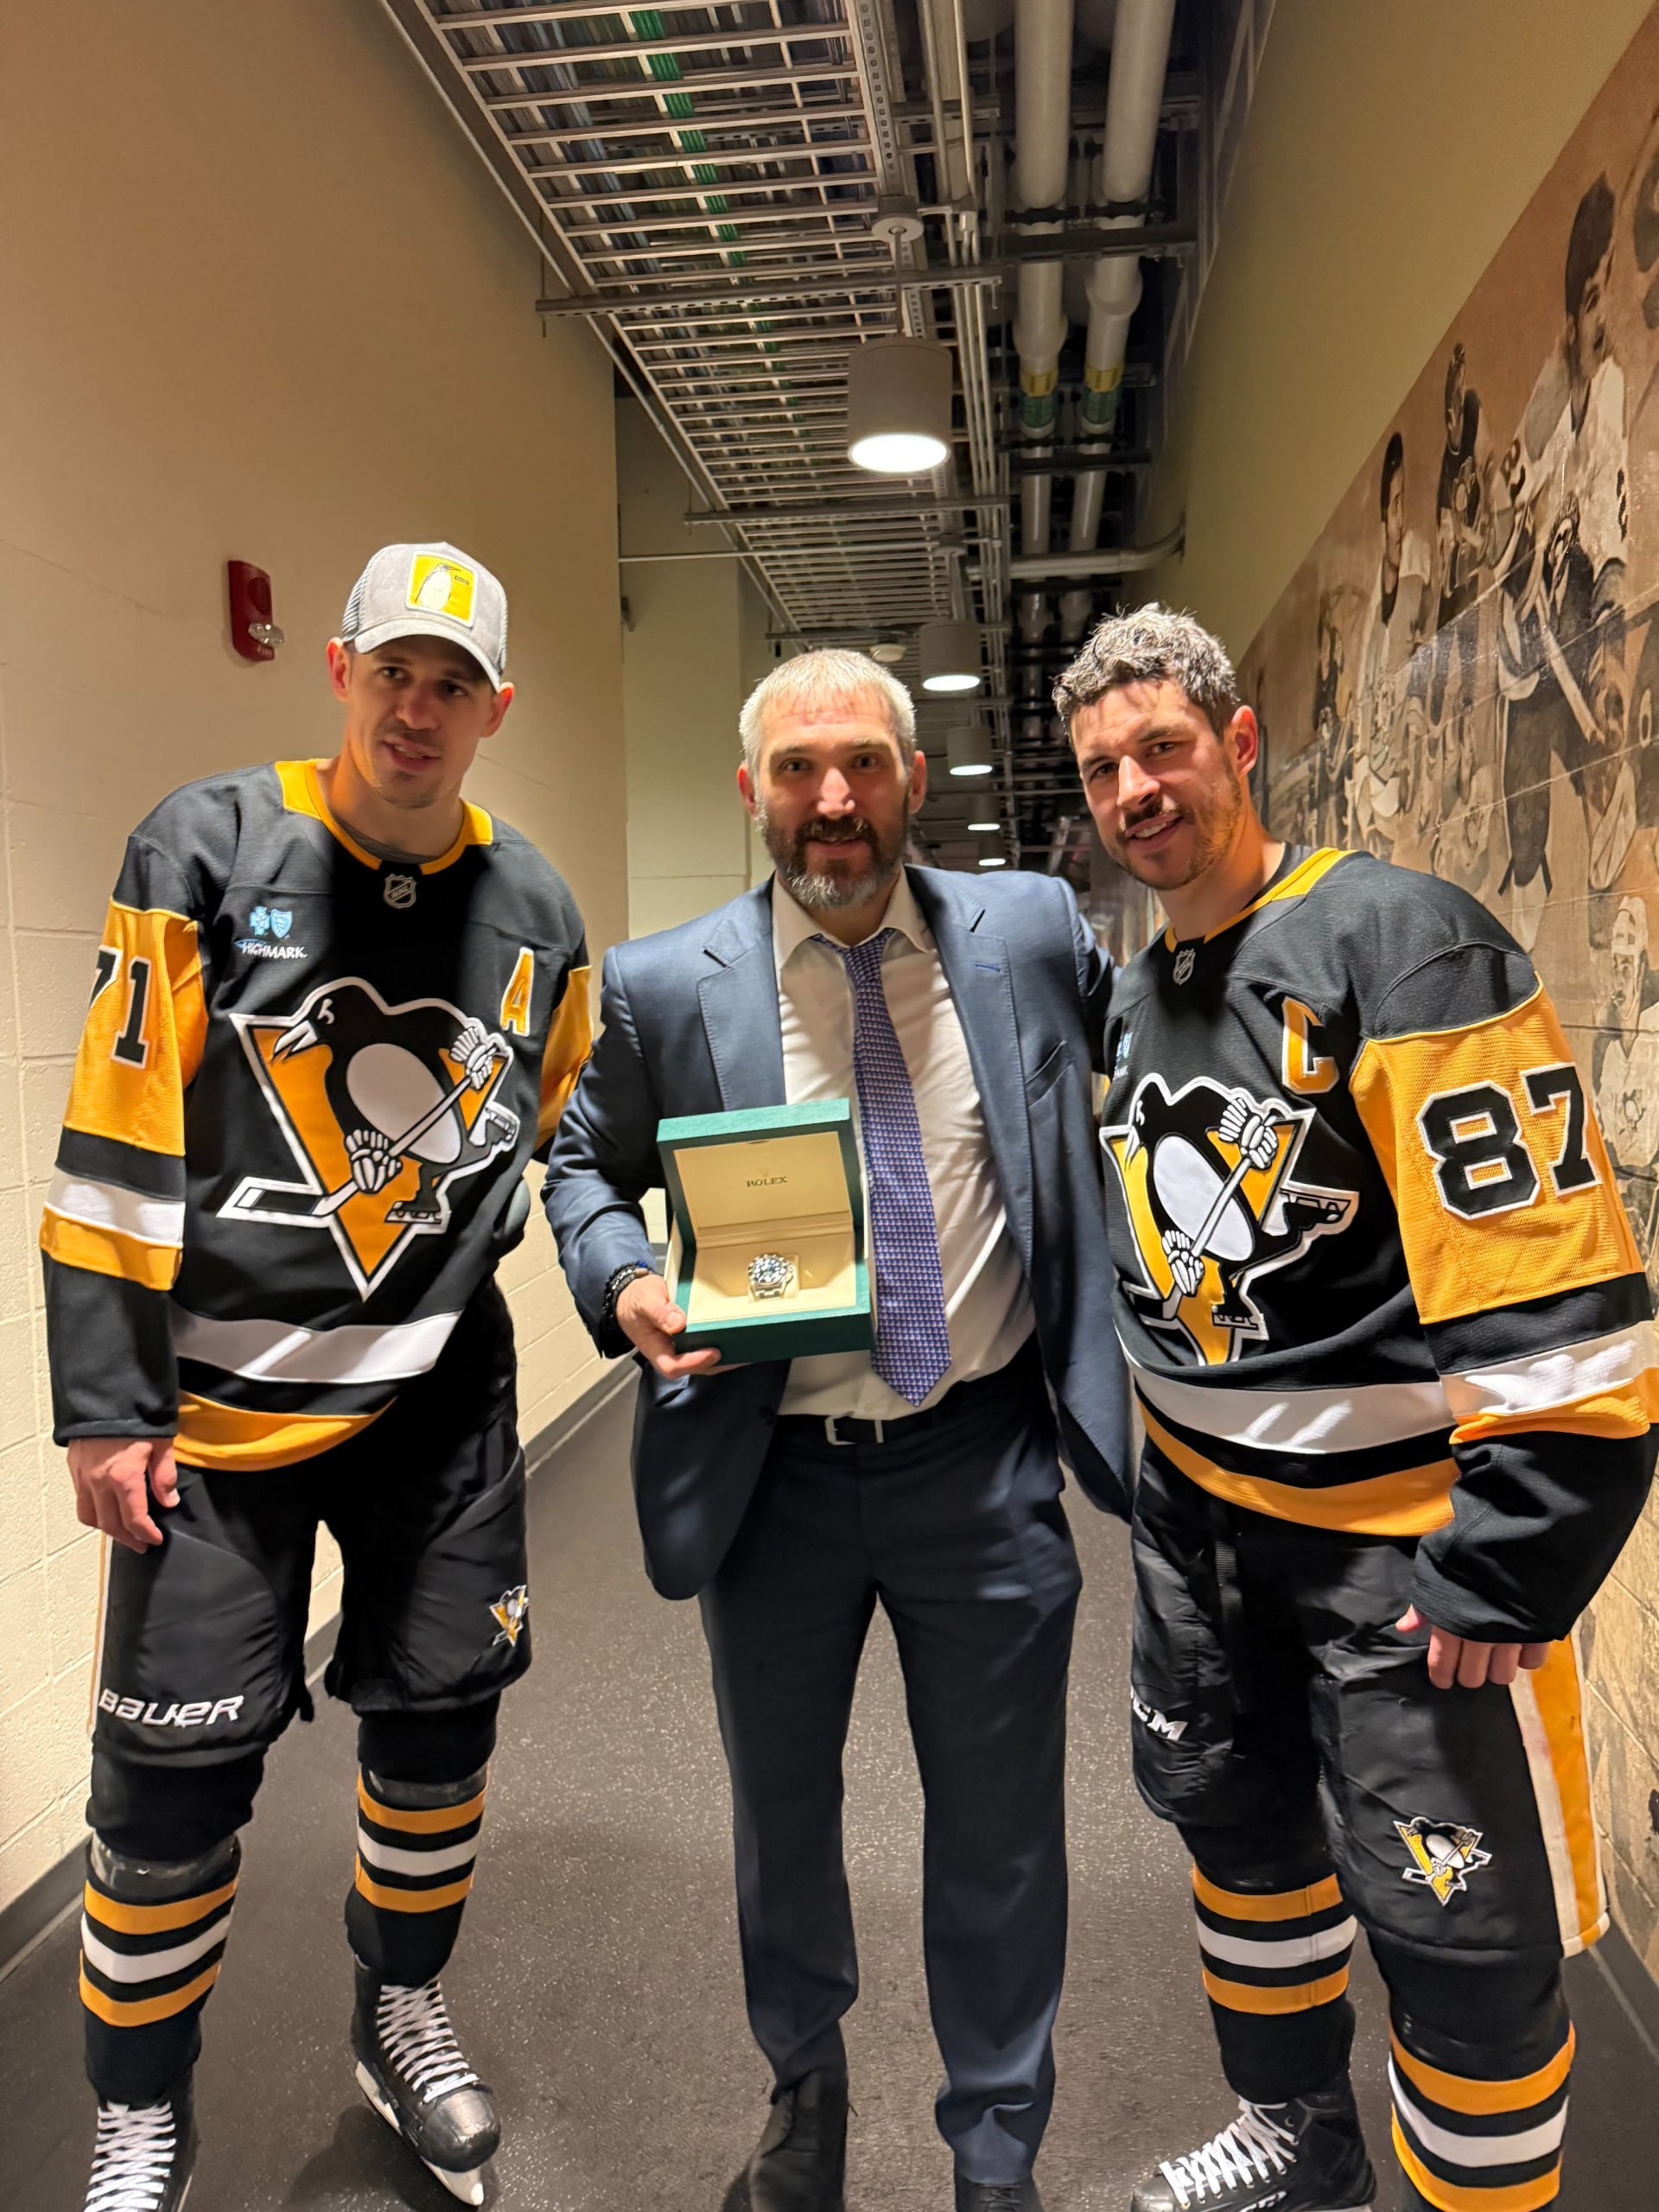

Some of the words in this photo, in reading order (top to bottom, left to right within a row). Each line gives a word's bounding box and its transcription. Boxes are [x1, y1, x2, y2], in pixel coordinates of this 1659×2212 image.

[88, 944, 151, 1069] 71
[499, 947, 534, 1037] A
[1281, 996, 1340, 1095] C
[747, 1176, 788, 1188] ROLEX
[1414, 1062, 1603, 1220] 87
